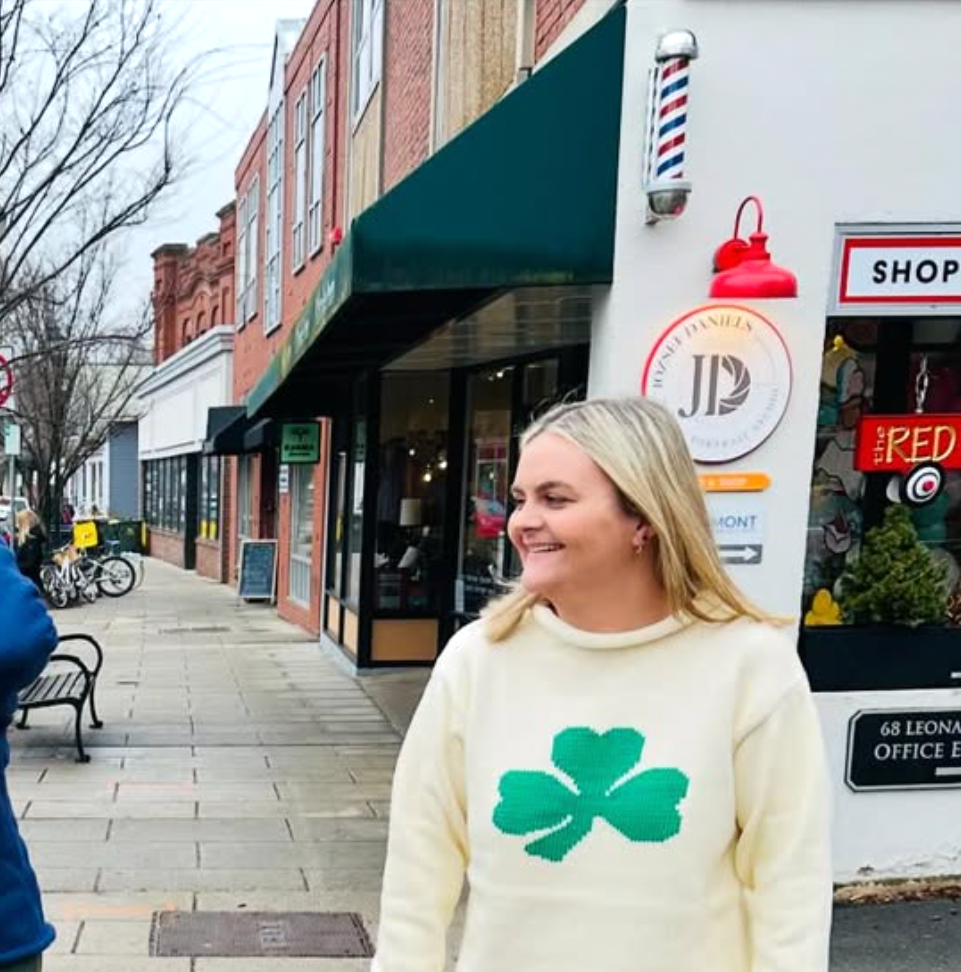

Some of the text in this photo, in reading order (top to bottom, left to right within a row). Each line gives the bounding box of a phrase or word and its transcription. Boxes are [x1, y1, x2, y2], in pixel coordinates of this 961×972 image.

[872, 259, 959, 284] SHOP
[684, 315, 752, 338] DANIELS
[873, 425, 957, 465] the RED
[880, 720, 901, 736] 68
[874, 742, 944, 761] OFFICE
